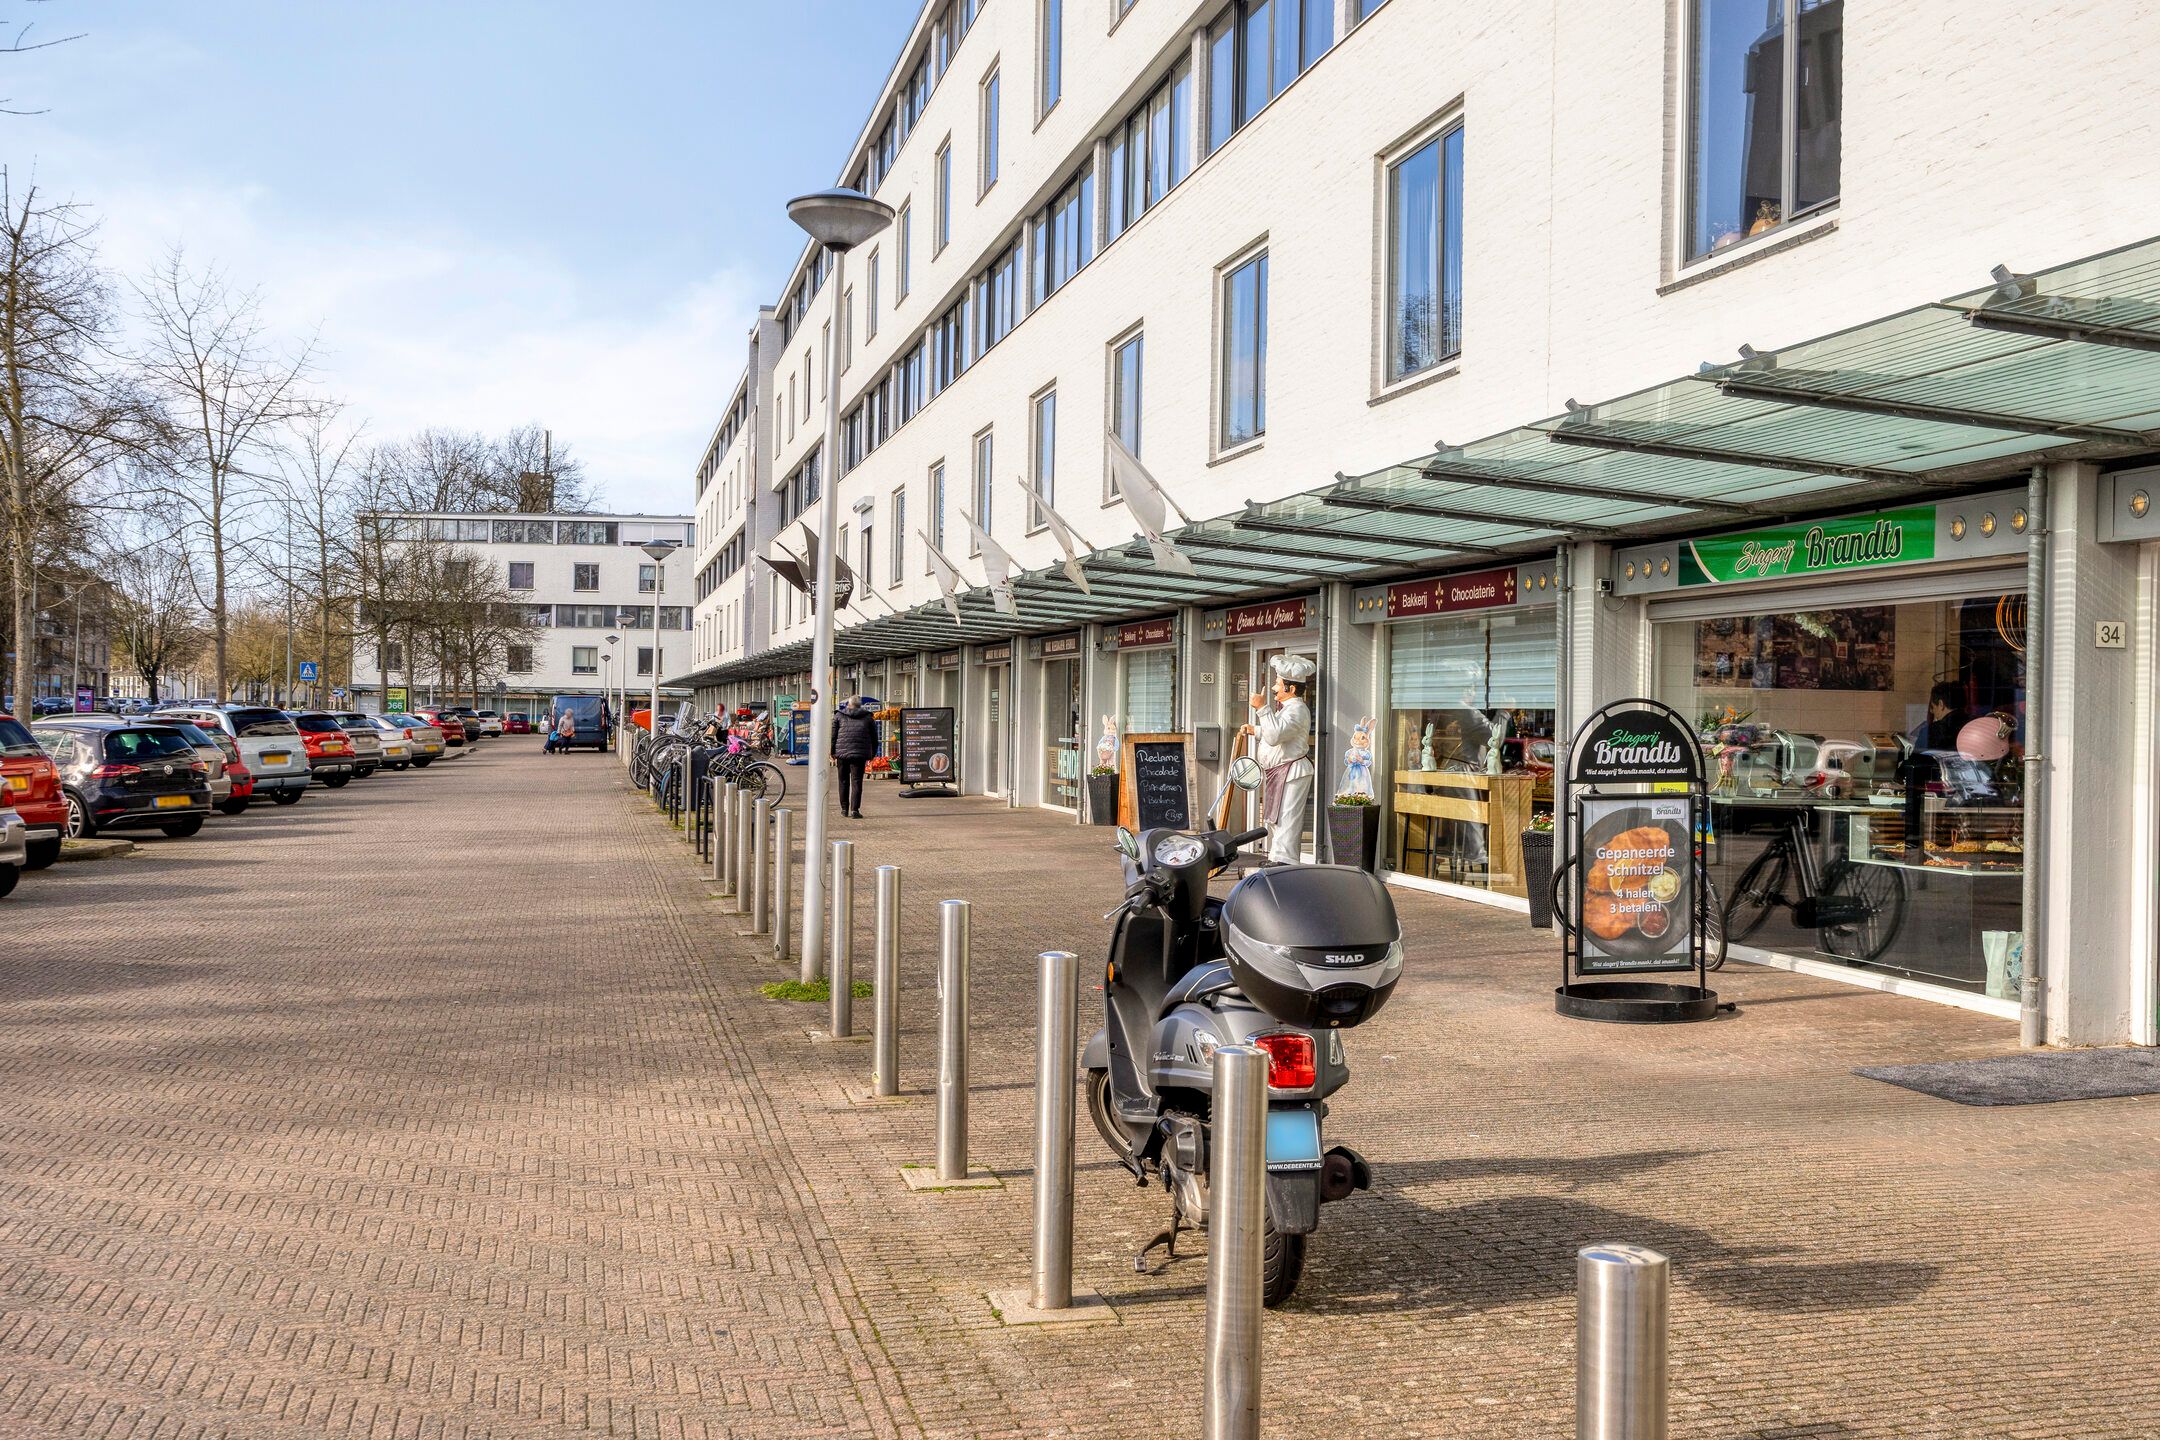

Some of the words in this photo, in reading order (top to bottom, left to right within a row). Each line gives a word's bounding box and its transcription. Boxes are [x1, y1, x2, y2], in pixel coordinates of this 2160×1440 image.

[1735, 539, 1796, 576] Slagerij
[1804, 519, 1903, 568] Brandts
[1402, 591, 1428, 608] Bakkerij
[1451, 583, 1495, 602] Chocolaterie
[1236, 612, 1256, 632] Crème
[1257, 611, 1264, 625] de
[1265, 609, 1272, 624] la
[1273, 607, 1294, 628] Crème
[2101, 625, 2120, 644] 34
[1202, 674, 1212, 682] 36
[1607, 729, 1660, 748] Slagerij
[1136, 749, 1181, 763] Reclame
[1594, 740, 1681, 765] Brandts
[1057, 748, 1079, 780] HEND
[1656, 806, 1682, 815] Brandts
[1596, 845, 1675, 861] Gepaneerde
[1606, 862, 1664, 877] Schnitzel
[1616, 890, 1623, 899] 4
[1626, 889, 1655, 899] halen
[1610, 904, 1617, 913] 3
[1619, 902, 1661, 913] betalen!
[1325, 954, 1364, 964] SHAD
